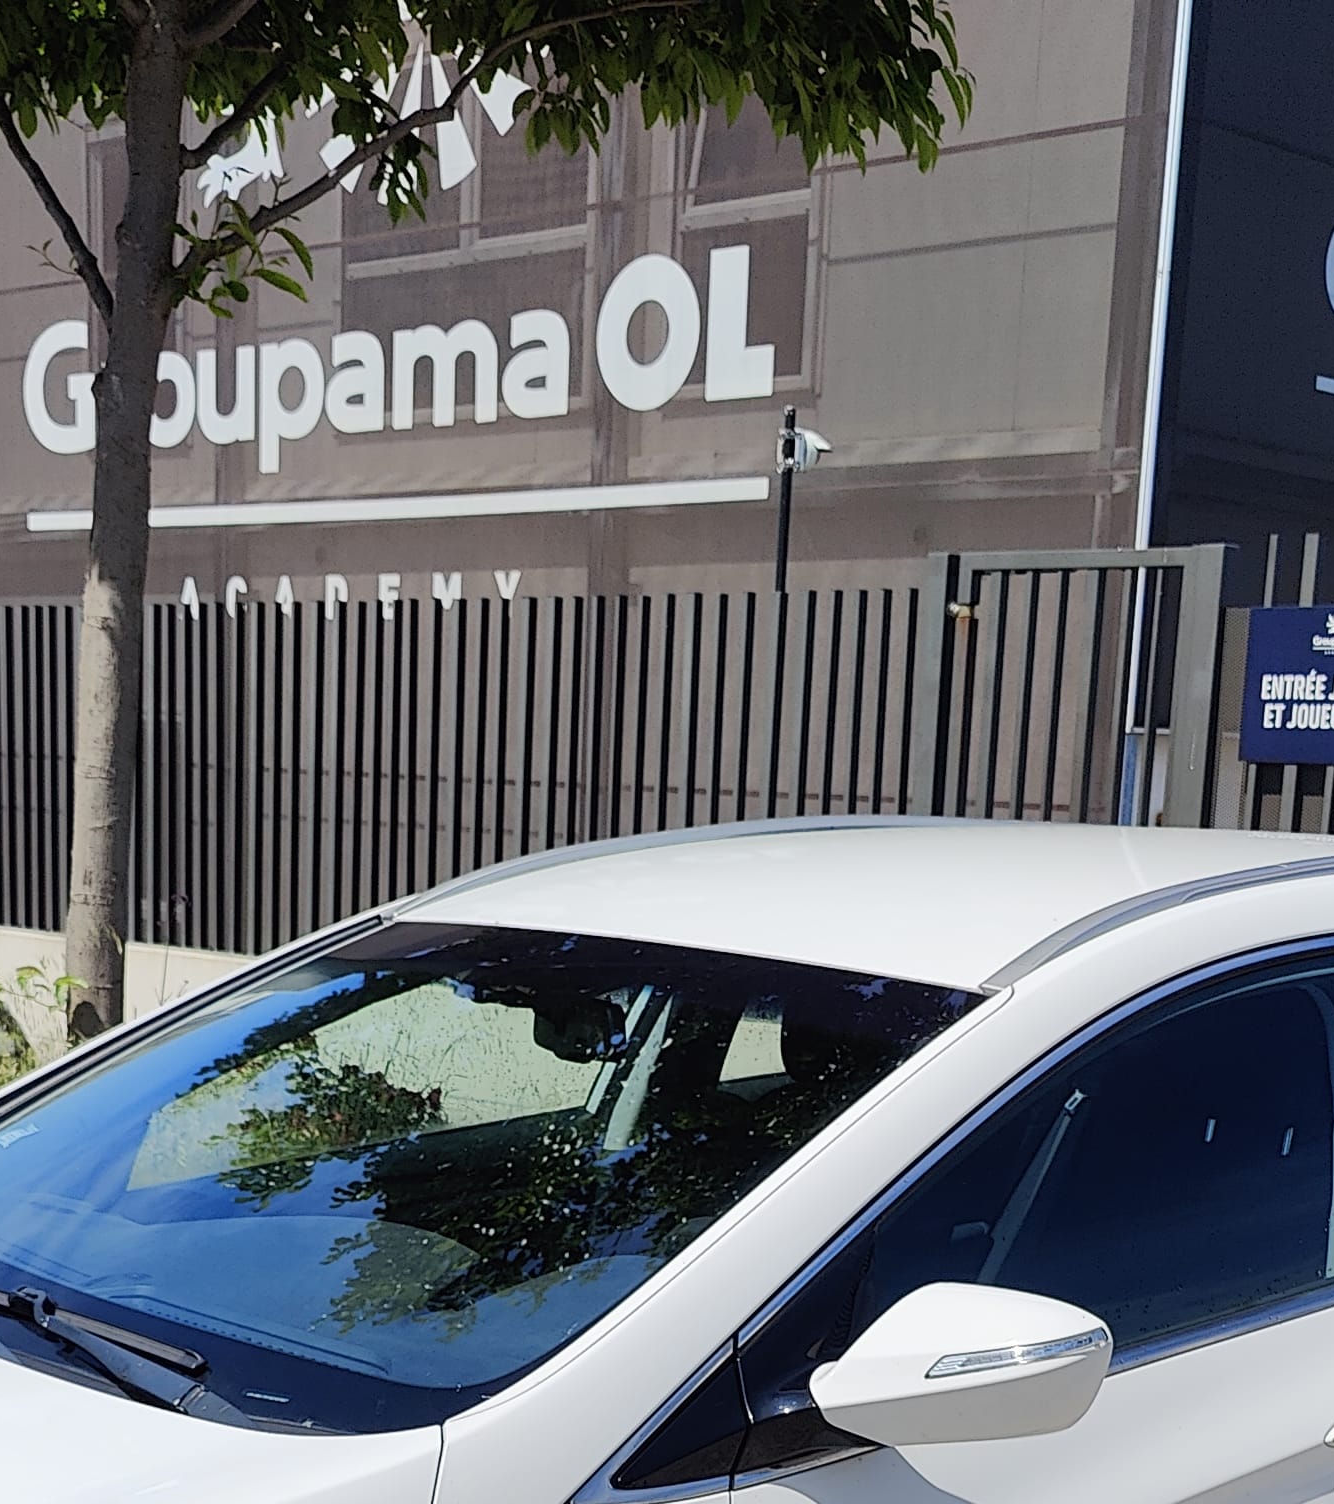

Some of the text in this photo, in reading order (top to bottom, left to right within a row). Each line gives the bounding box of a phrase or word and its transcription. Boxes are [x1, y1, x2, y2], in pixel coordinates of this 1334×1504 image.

[23, 244, 775, 475] Goupama OL
[178, 569, 523, 621] ACADEMY
[1261, 668, 1328, 701] ENTRÉE
[1263, 703, 1286, 729] ET
